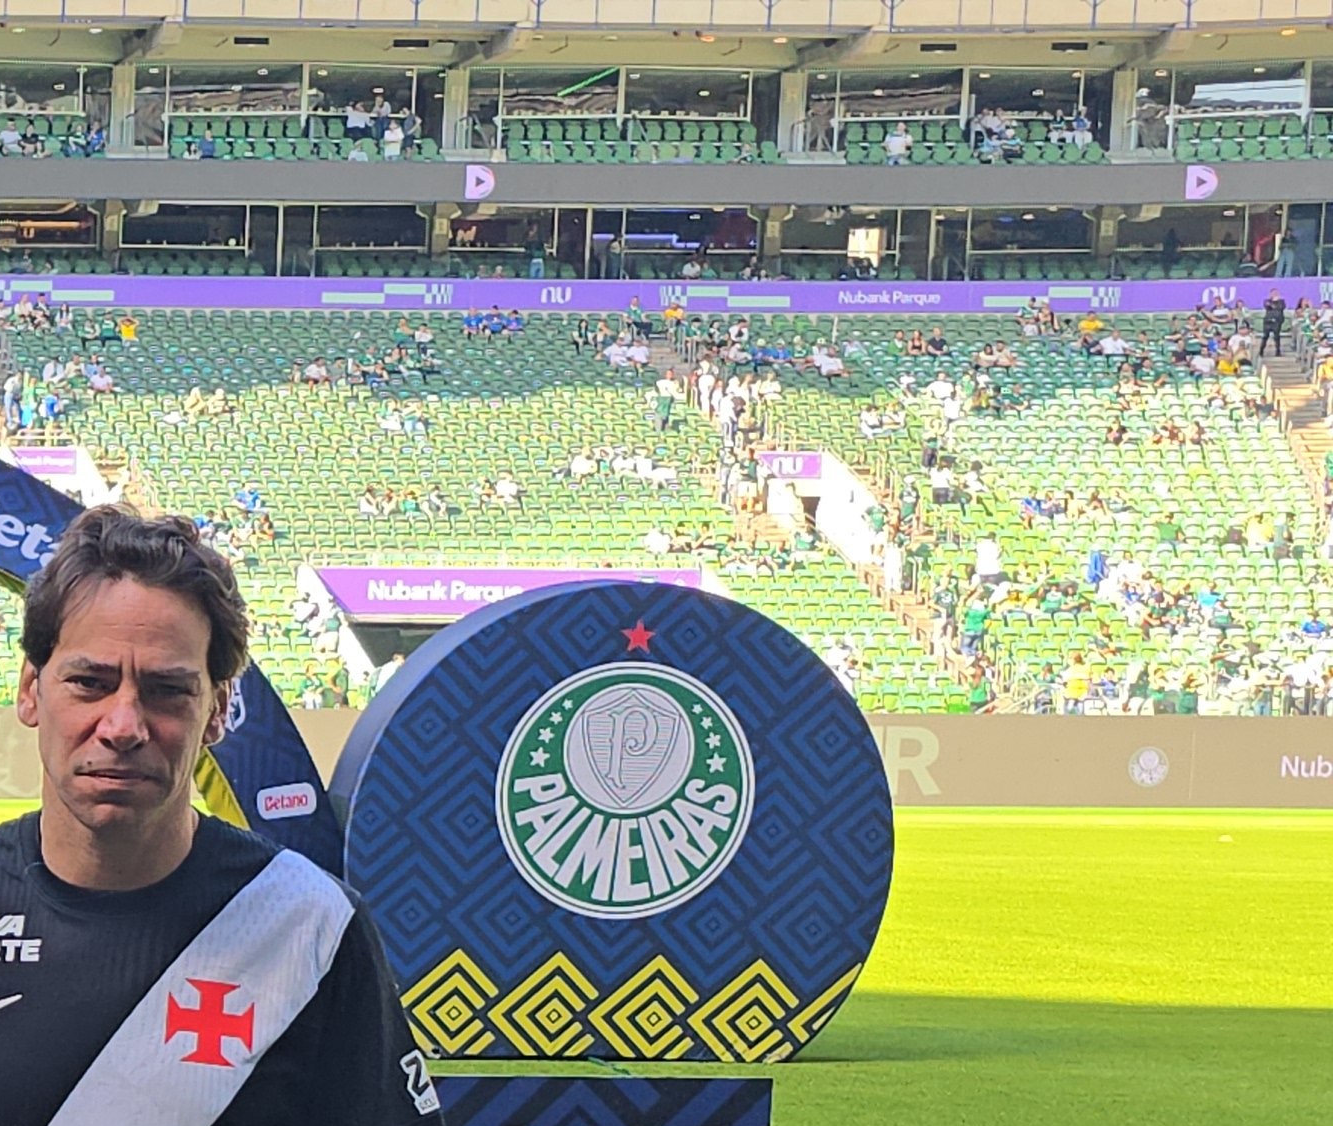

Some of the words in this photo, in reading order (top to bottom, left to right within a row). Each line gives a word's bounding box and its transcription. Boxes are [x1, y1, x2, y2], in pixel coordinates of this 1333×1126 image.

[838, 290, 891, 305] Nubank
[892, 291, 942, 306] Parque
[367, 579, 448, 601] Nubank
[1281, 755, 1333, 778] Nub
[264, 794, 309, 812] Betano
[513, 773, 738, 901] PALMEIRAS
